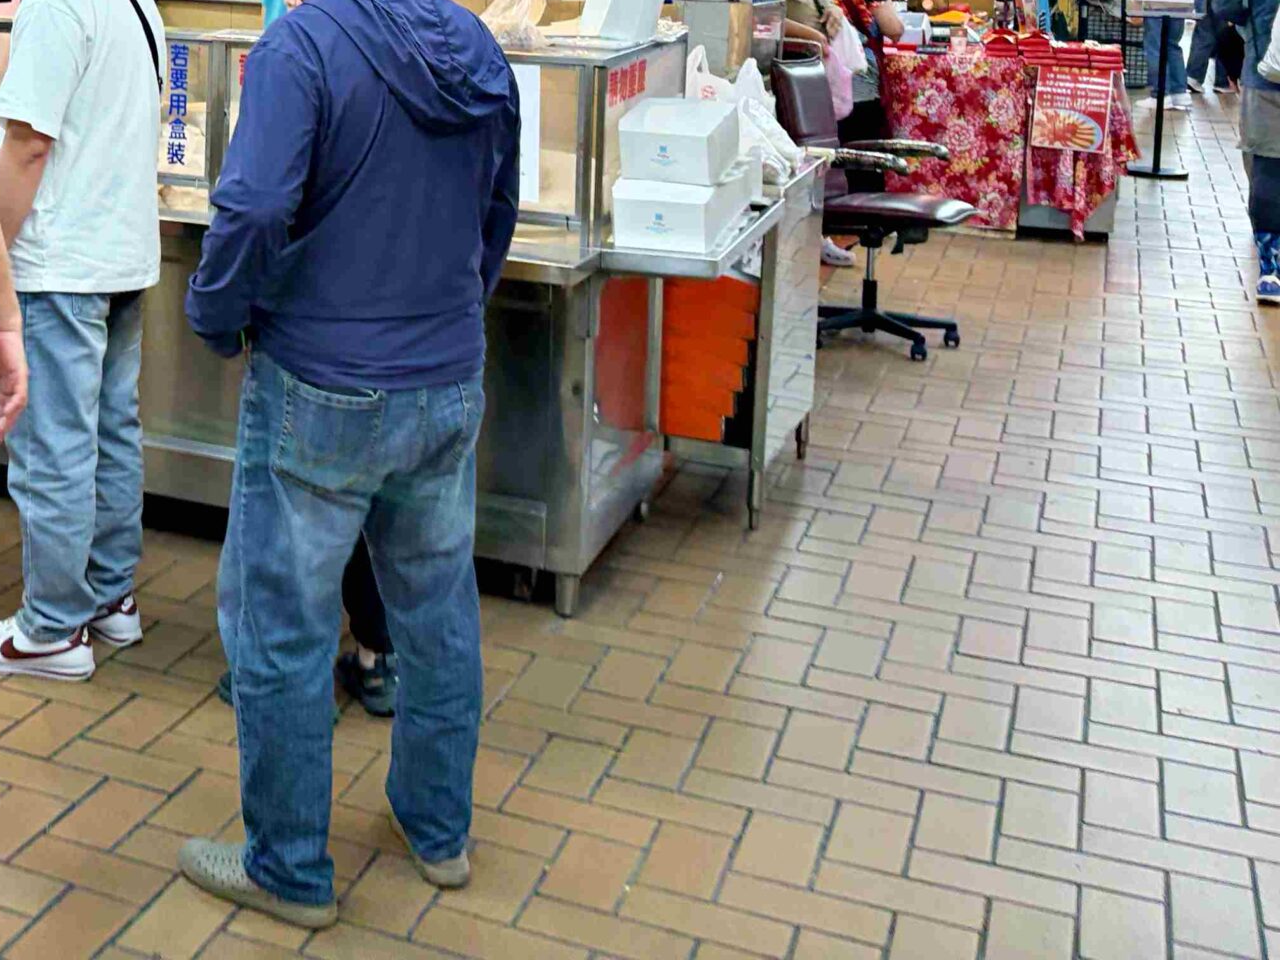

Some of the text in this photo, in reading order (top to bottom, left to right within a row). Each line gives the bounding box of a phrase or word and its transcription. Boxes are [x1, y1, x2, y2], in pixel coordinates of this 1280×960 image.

[166, 43, 190, 166] 若要用盒裝
